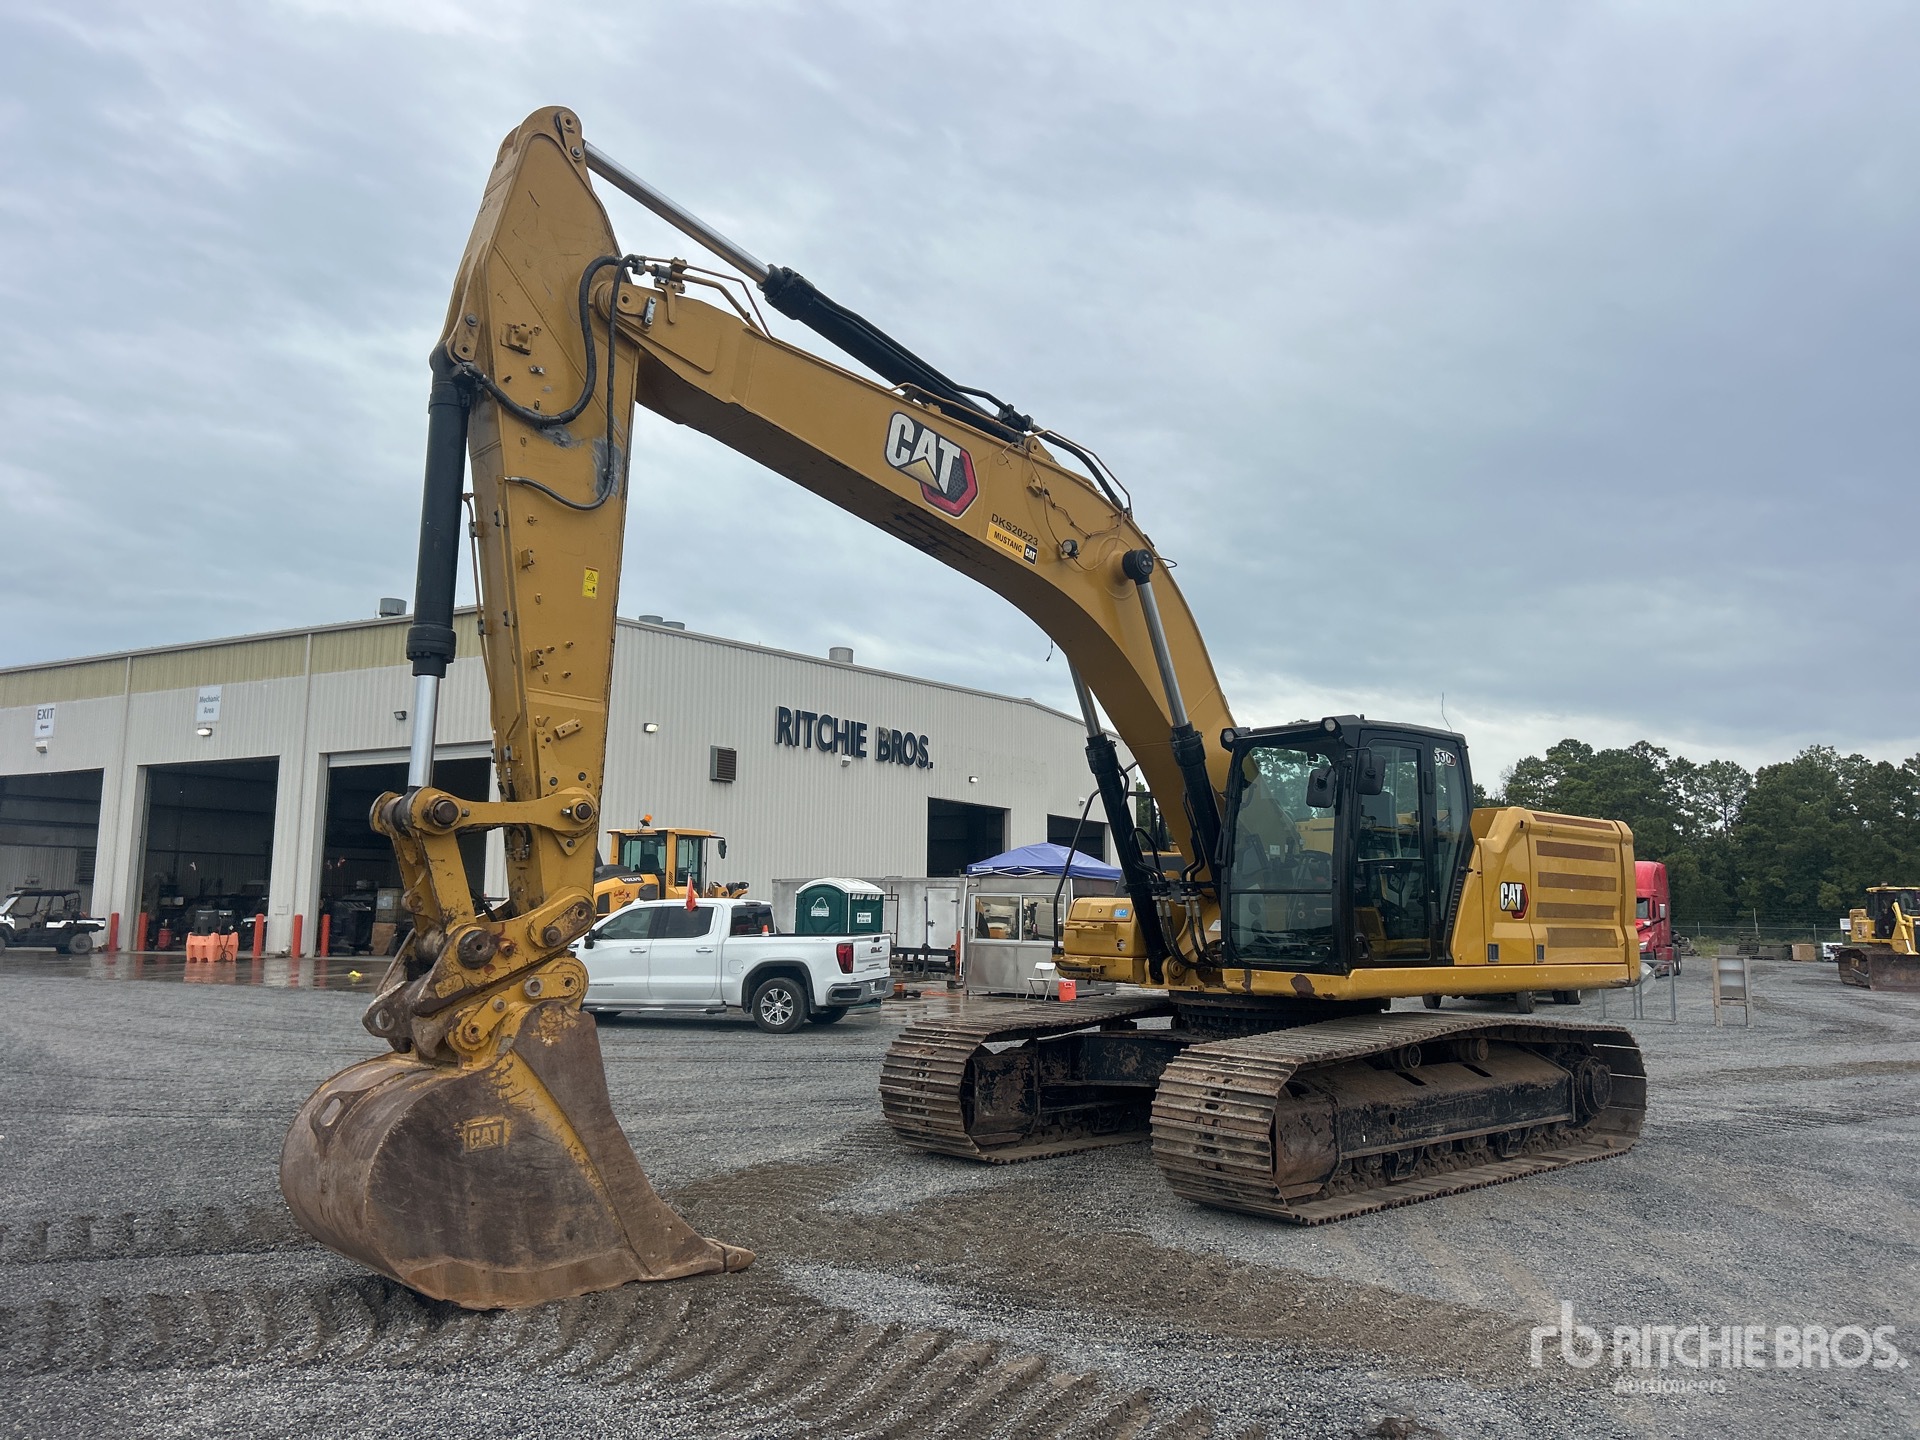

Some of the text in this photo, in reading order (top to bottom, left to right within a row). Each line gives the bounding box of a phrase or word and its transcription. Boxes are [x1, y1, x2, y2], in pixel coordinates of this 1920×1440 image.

[886, 412, 961, 495] CAT
[991, 513, 1039, 546] DKS20223
[993, 531, 1023, 554] MUSTANG
[1024, 545, 1037, 561] CAT
[199, 695, 220, 703] Mechanic
[37, 708, 55, 720] EXIT
[775, 706, 934, 769] RITCHIE BROS.
[1500, 882, 1523, 911] CAT
[469, 1125, 501, 1149] CAT
